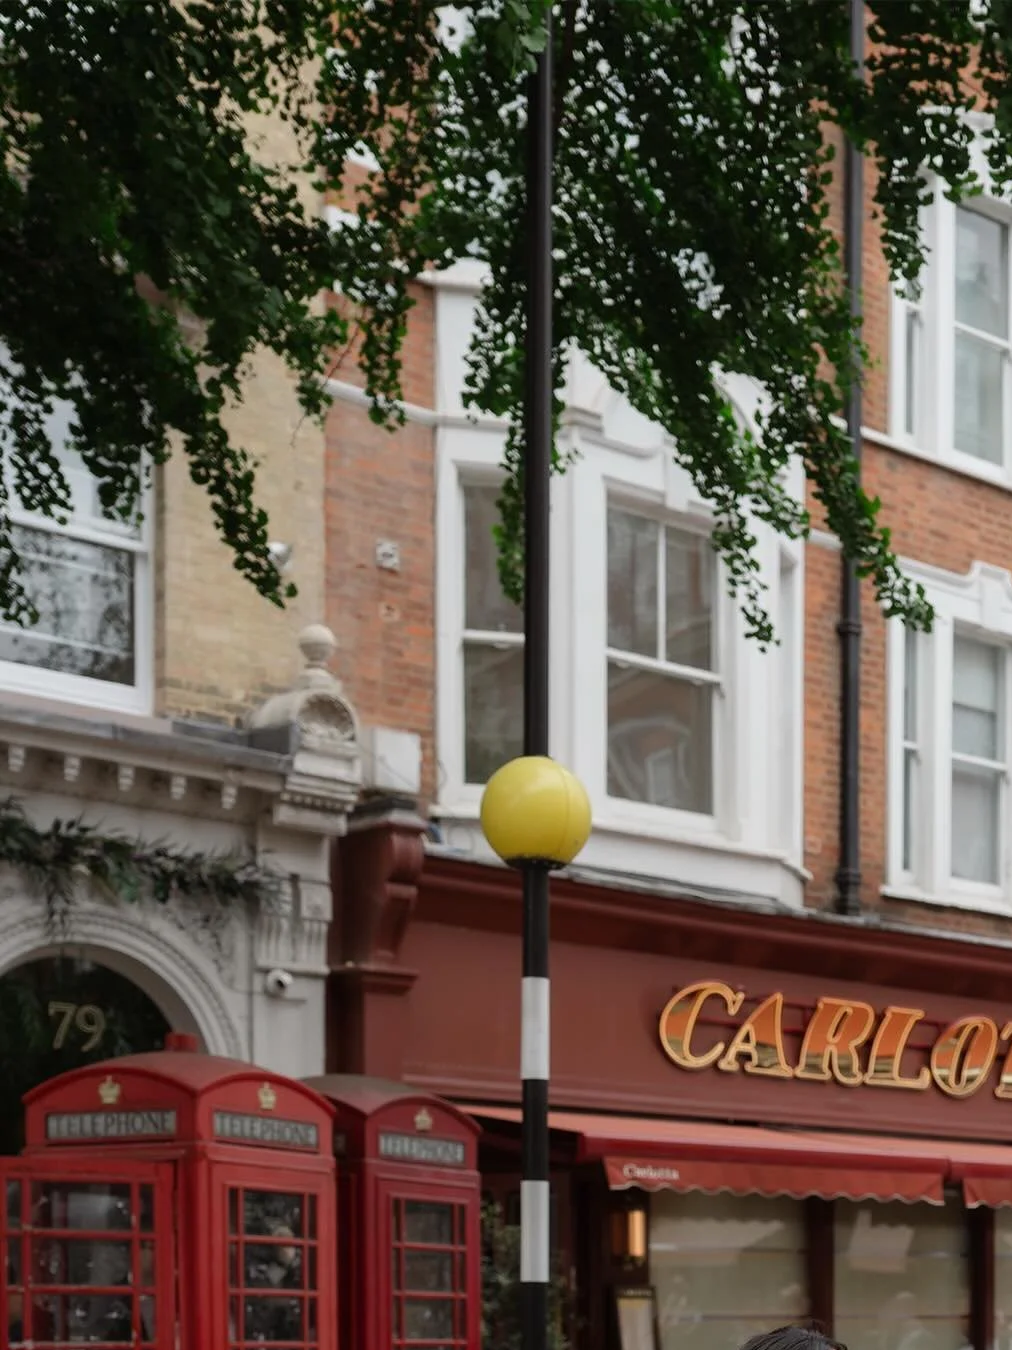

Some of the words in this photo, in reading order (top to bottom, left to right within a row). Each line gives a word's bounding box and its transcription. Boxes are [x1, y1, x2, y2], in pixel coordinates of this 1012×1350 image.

[48, 1001, 106, 1052] 79
[54, 1111, 170, 1138] TELEPHONE
[217, 1114, 317, 1145] TELEPHONE
[384, 1136, 464, 1162] TELEPHONE
